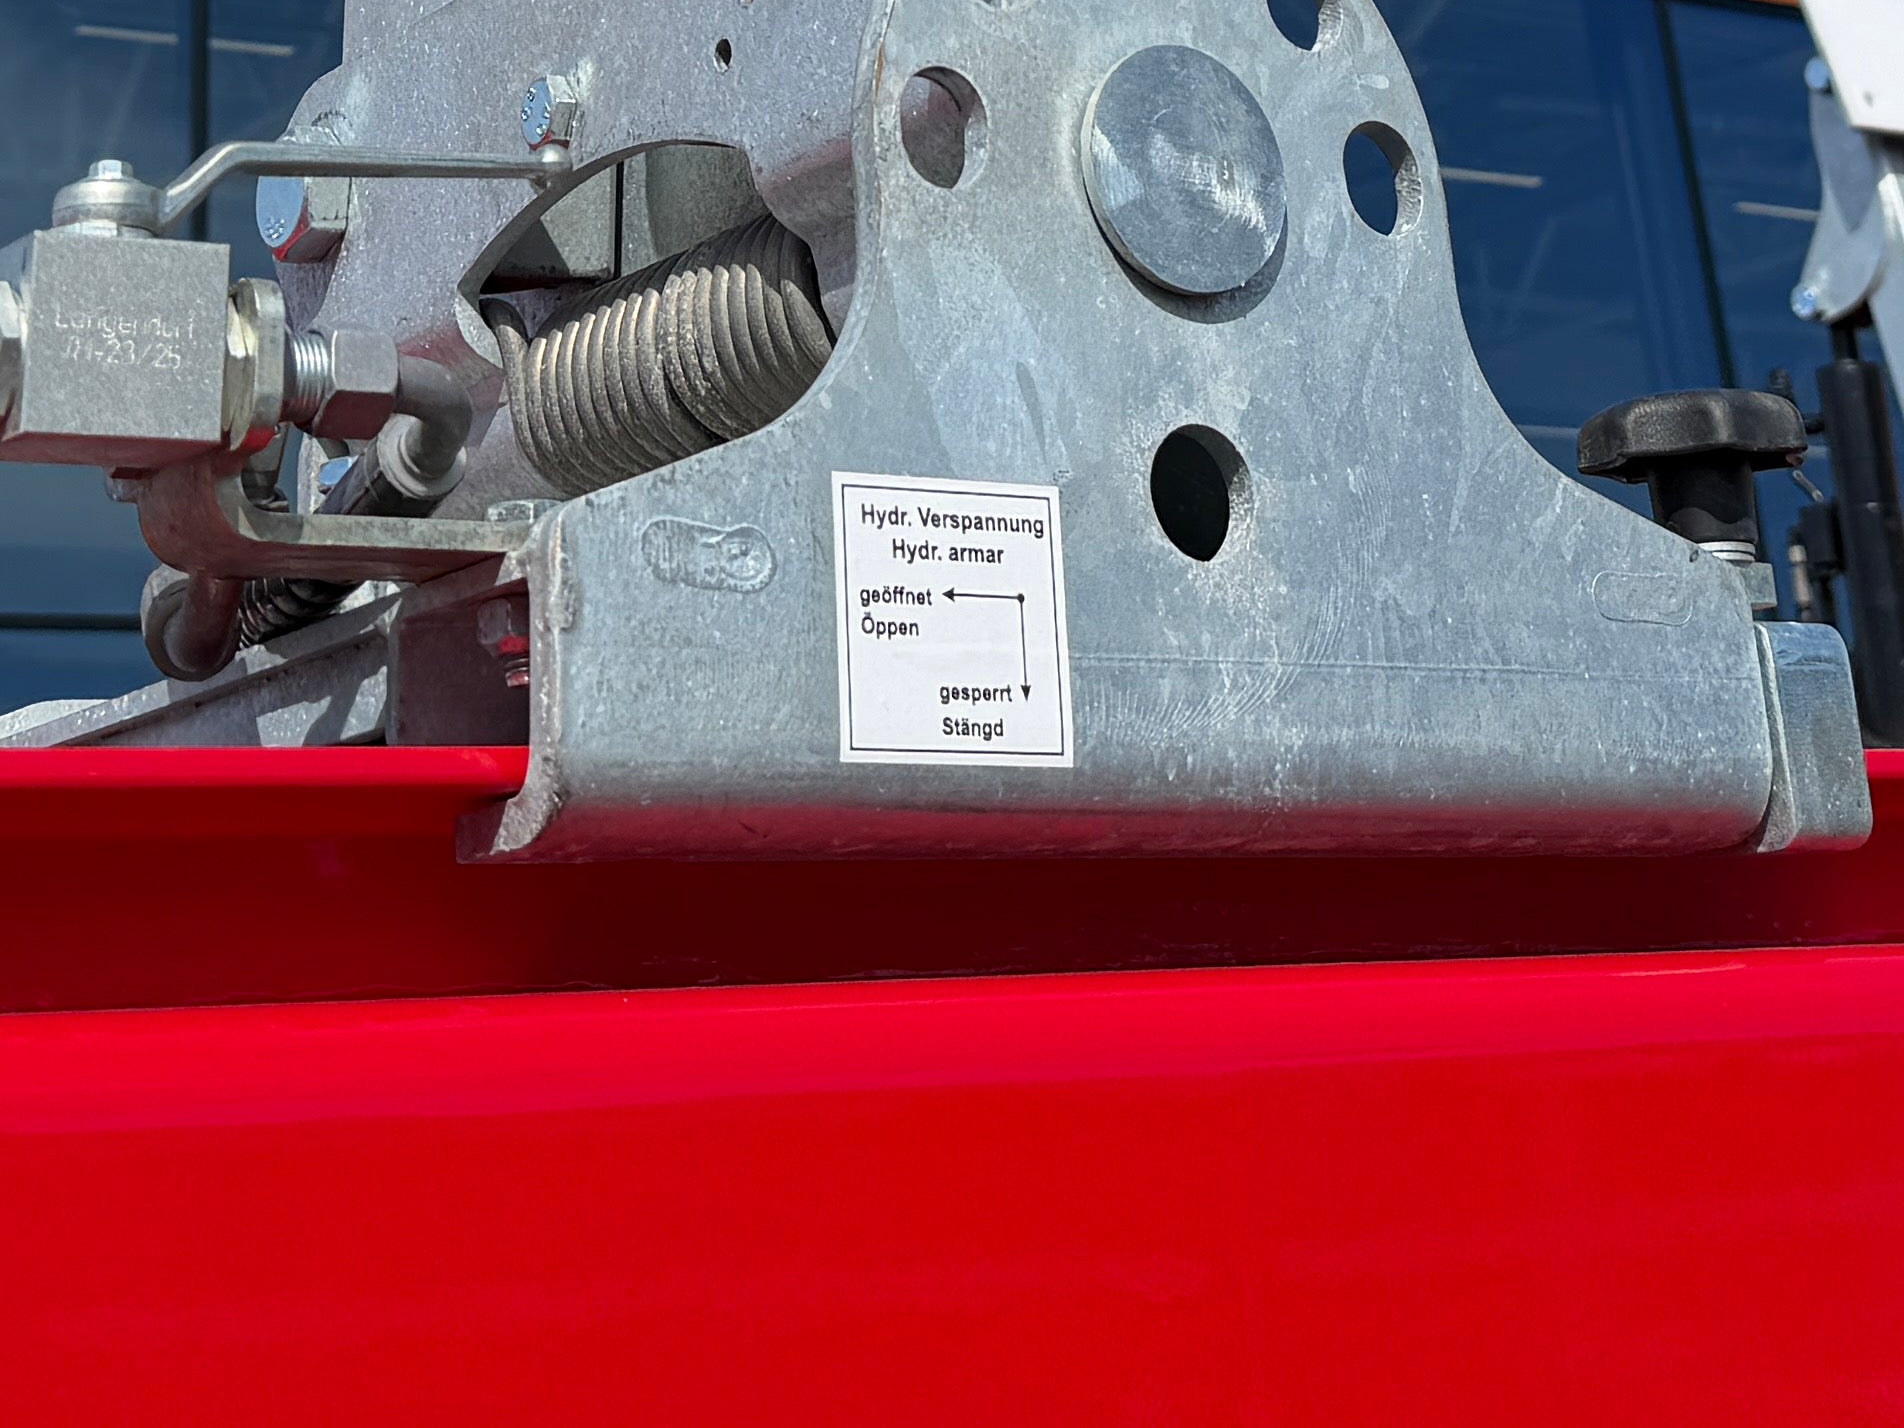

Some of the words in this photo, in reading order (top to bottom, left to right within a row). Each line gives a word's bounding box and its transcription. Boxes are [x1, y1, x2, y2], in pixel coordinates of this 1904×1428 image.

[860, 503, 912, 530] Hydr.
[917, 506, 1045, 539] Verspannung
[891, 538, 943, 564] Hydr.
[948, 545, 1004, 564] armar
[859, 586, 933, 607] geöffnet
[860, 612, 920, 640] Öppen
[939, 685, 1013, 704] gesperrt
[942, 717, 1004, 742] Stängd
